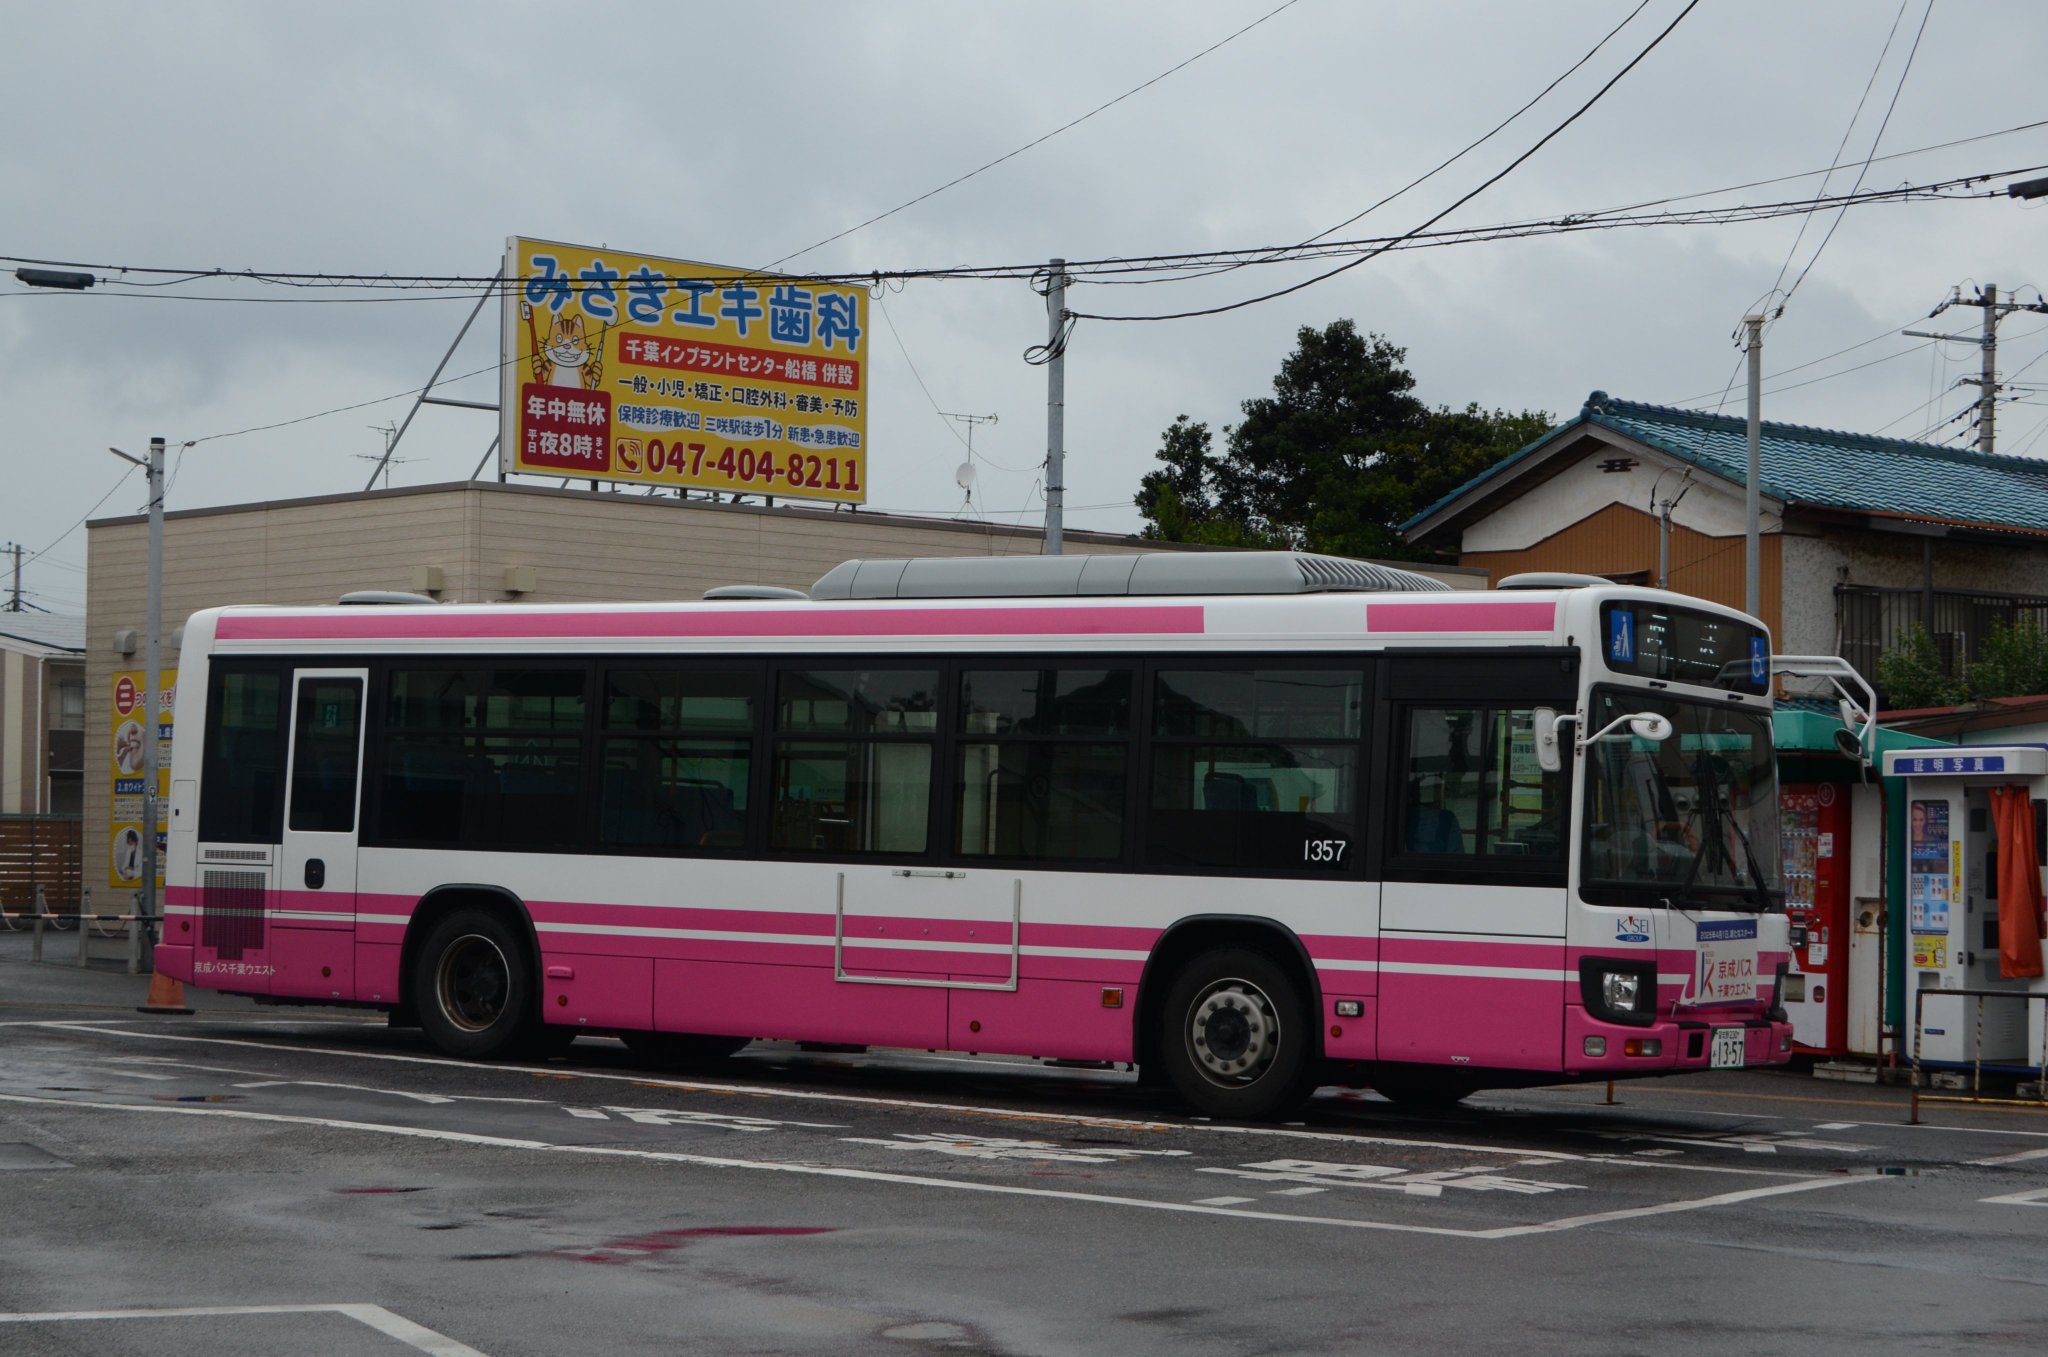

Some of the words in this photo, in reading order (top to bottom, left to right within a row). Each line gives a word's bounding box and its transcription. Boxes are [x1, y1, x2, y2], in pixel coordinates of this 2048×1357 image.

[526, 257, 860, 350] みさきエキ歯科
[626, 339, 817, 382] 千葉インプラントセンター船橋
[822, 363, 853, 385] 併設
[527, 395, 606, 426] 年中無休
[618, 404, 700, 430] 保険診療歓迎
[705, 417, 783, 439] 三咲駅徒歩1分
[788, 426, 860, 448] 新患・急患歓迎
[528, 428, 538, 454] 平日
[540, 430, 593, 459] 夜8時
[646, 438, 860, 492] 047-404-8211
[1913, 757, 1985, 772] 証明写真
[1304, 839, 1346, 862] 1357
[194, 962, 276, 976] 京成バス千葉ウエスト
[1718, 958, 1752, 979] 京成バス
[1717, 983, 1751, 997] 千葉ウエスト
